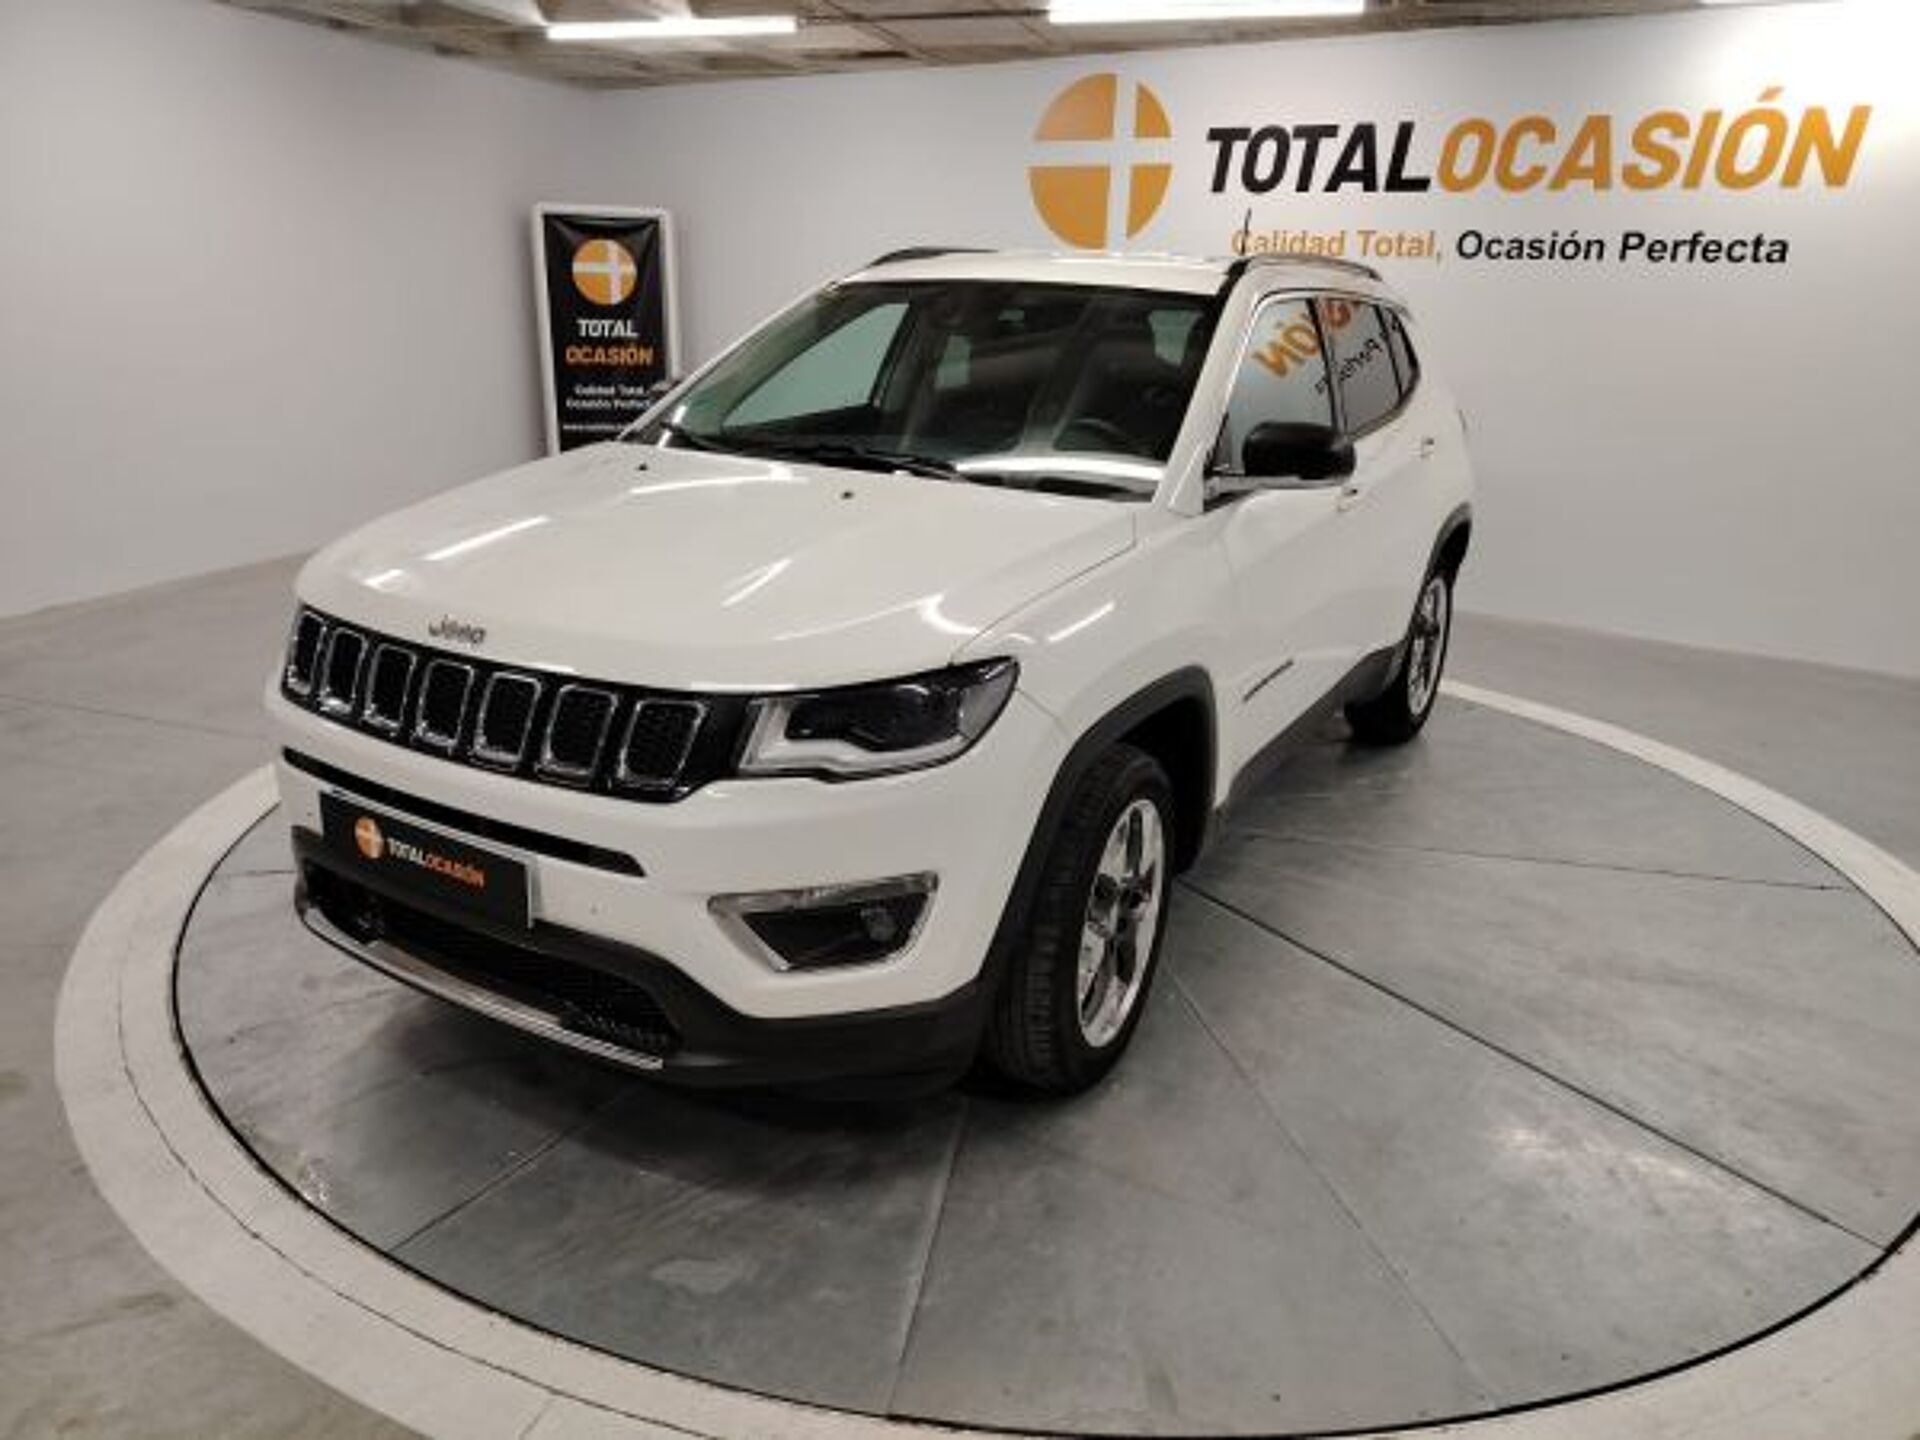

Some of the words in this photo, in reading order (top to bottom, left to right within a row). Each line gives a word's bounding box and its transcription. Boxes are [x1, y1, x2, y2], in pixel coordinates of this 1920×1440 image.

[1231, 229, 1346, 257] Calidad
[1357, 229, 1443, 265] Total,
[1456, 230, 1605, 261] Ocasión
[1618, 231, 1790, 264] Perfecta
[577, 319, 639, 338] TOTAL
[565, 342, 654, 366] OCASIÓN
